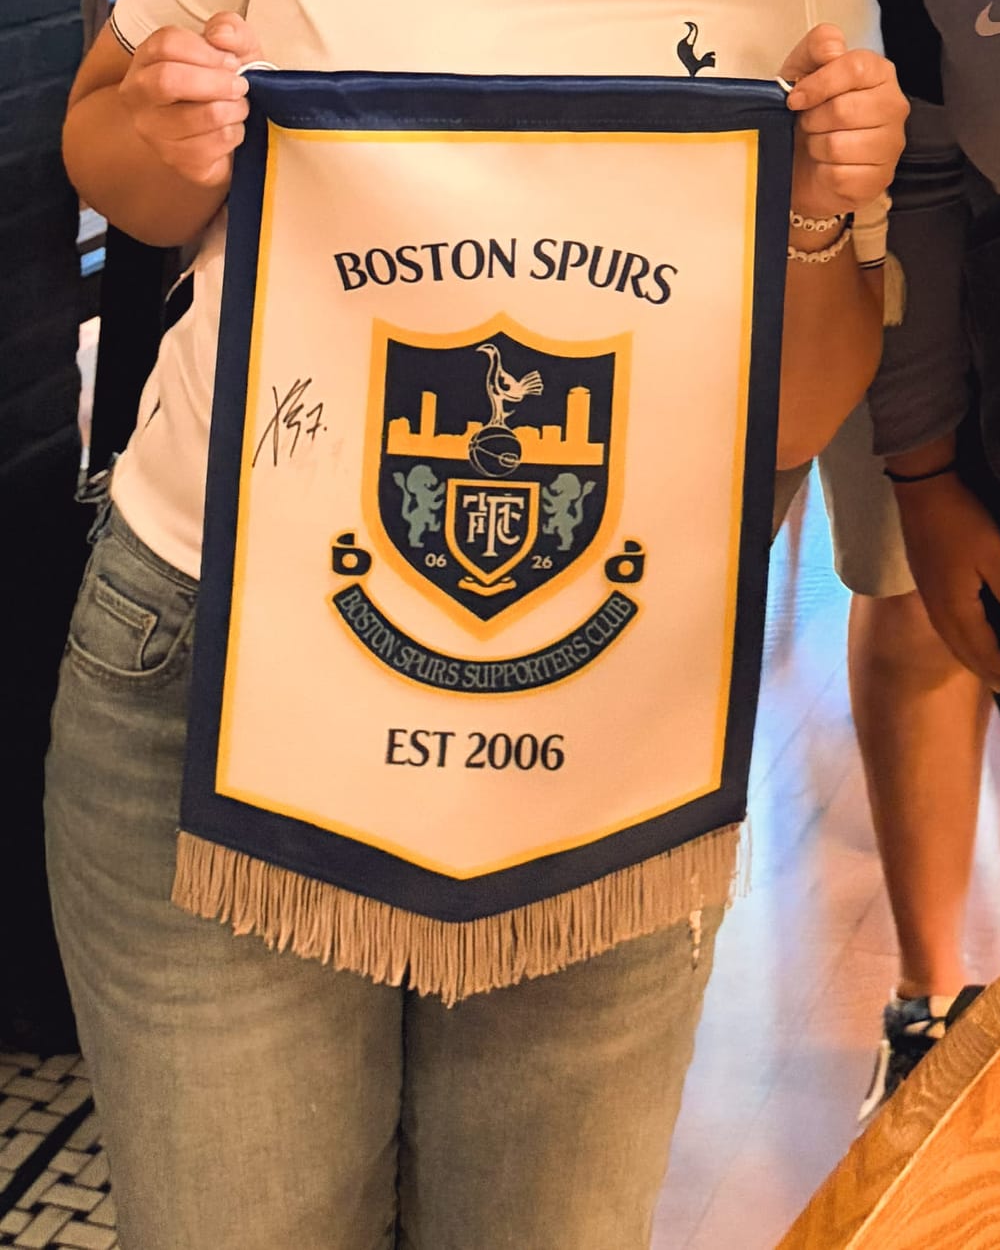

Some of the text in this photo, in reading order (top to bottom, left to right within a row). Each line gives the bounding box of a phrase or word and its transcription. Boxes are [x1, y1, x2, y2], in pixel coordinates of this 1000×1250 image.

[334, 238, 679, 305] BOSTON SPURS
[424, 553, 553, 570] 06 26
[339, 590, 632, 688] BOSTON SPURS SUPPORTERS CLUB
[385, 728, 565, 771] EST 2006
